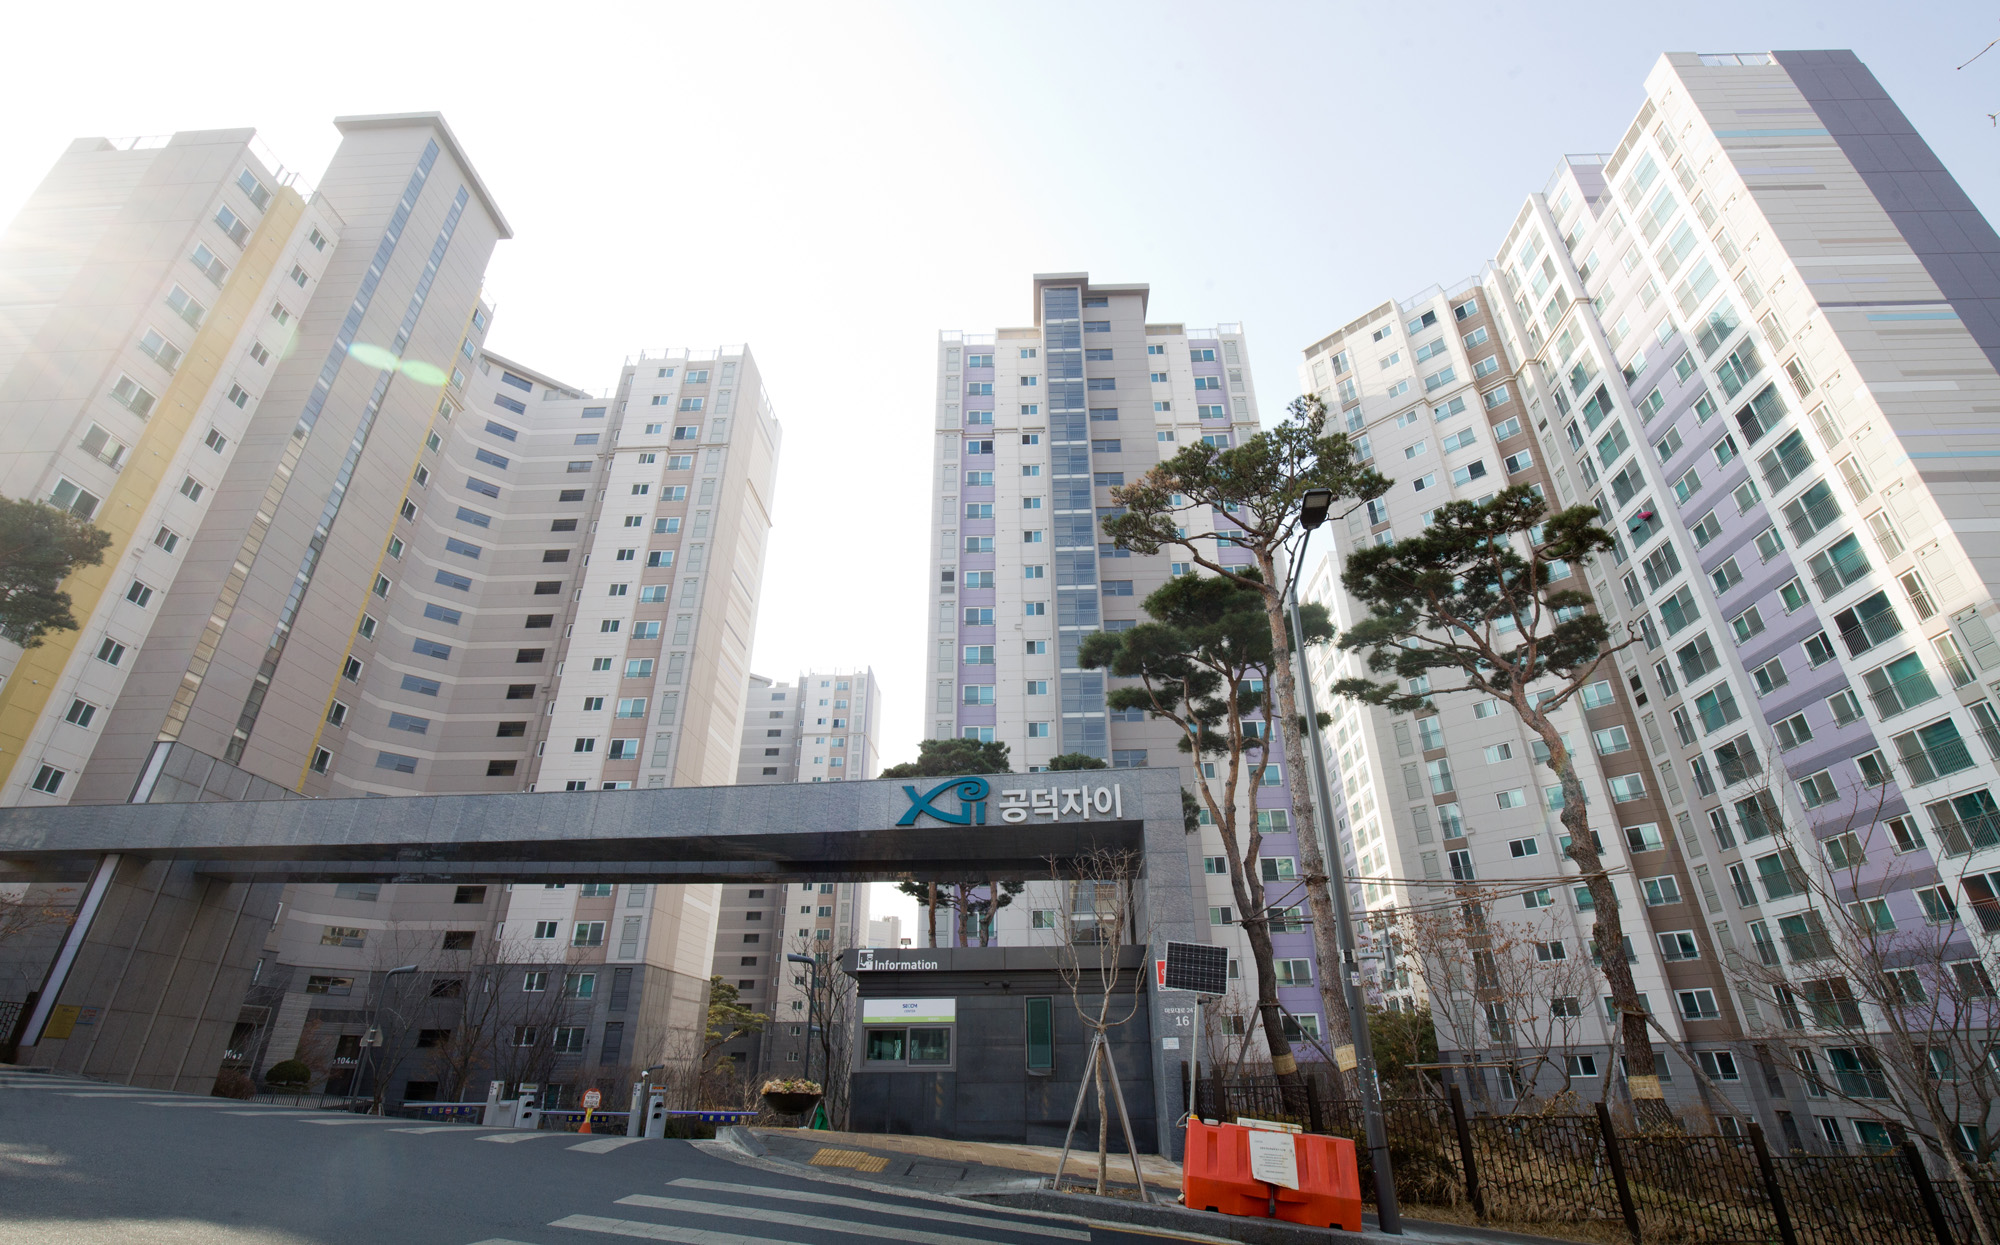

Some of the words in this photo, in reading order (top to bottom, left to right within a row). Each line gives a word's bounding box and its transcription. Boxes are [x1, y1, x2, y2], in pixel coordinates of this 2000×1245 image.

[999, 783, 1123, 823] 공덕자이
[874, 959, 938, 970] Information
[1175, 1015, 1190, 1026] 16
